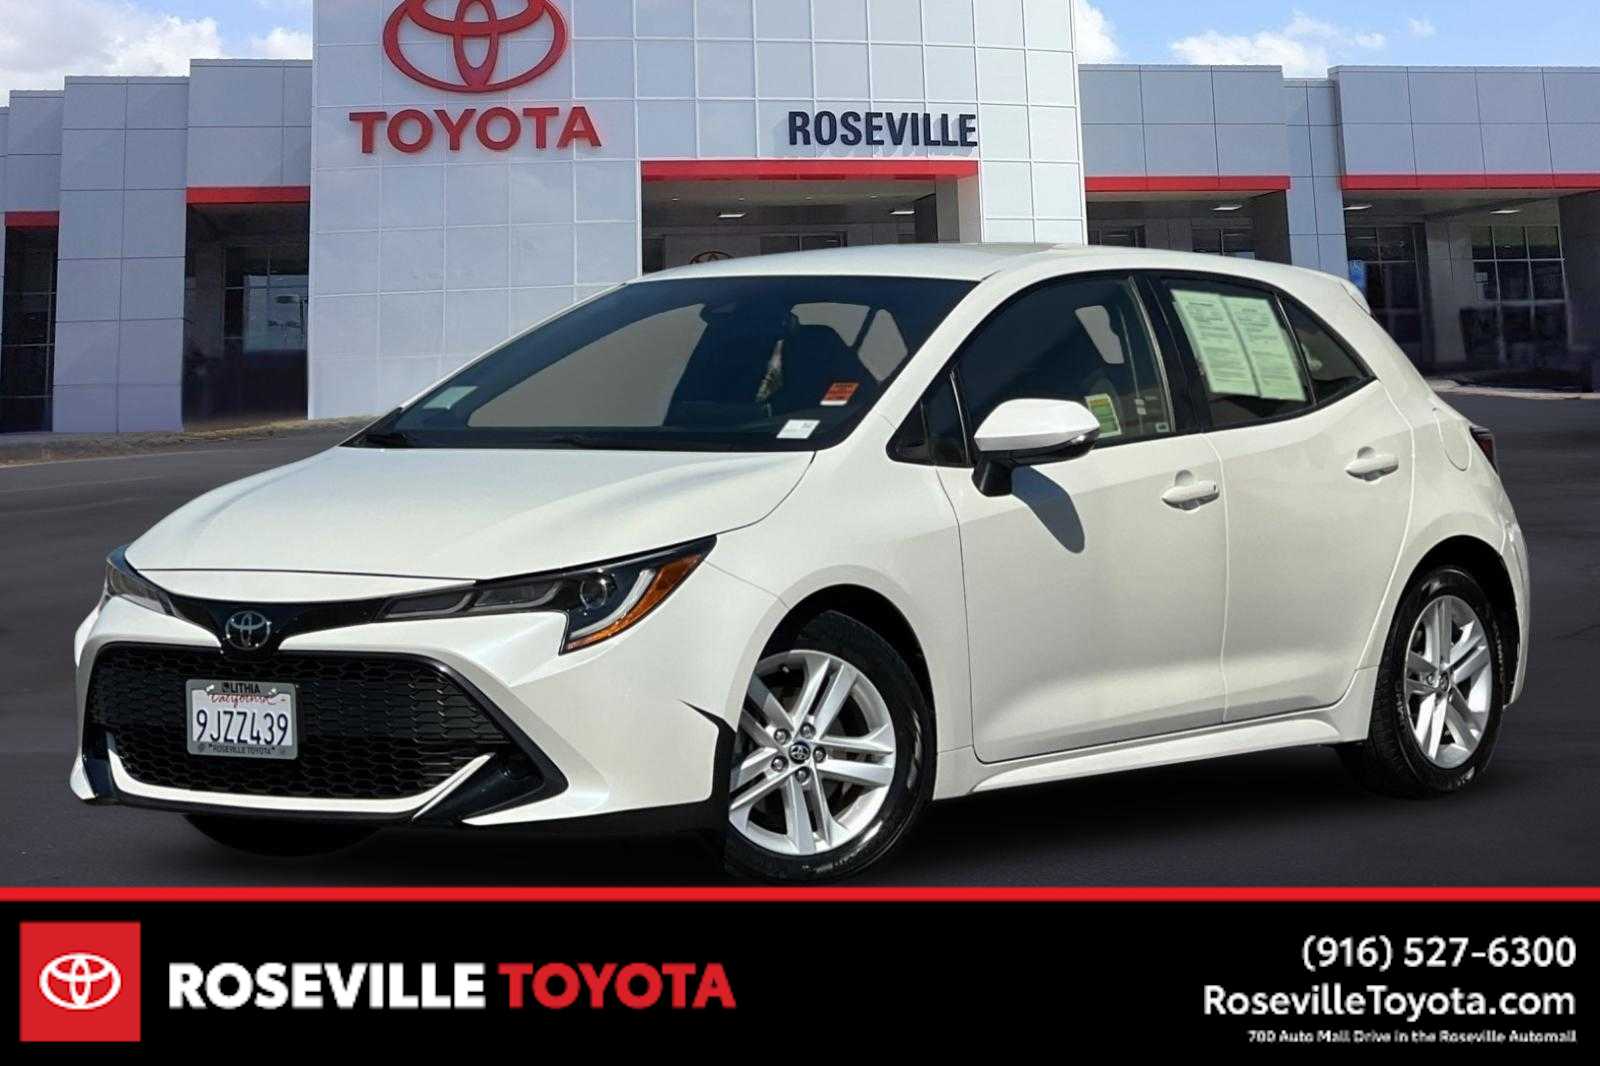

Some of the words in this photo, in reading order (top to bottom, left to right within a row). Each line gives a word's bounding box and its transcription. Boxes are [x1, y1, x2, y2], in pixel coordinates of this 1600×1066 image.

[349, 106, 602, 154] TOYOTA
[789, 110, 978, 147] ROSEVILLE
[196, 708, 288, 746] 9JZZ439
